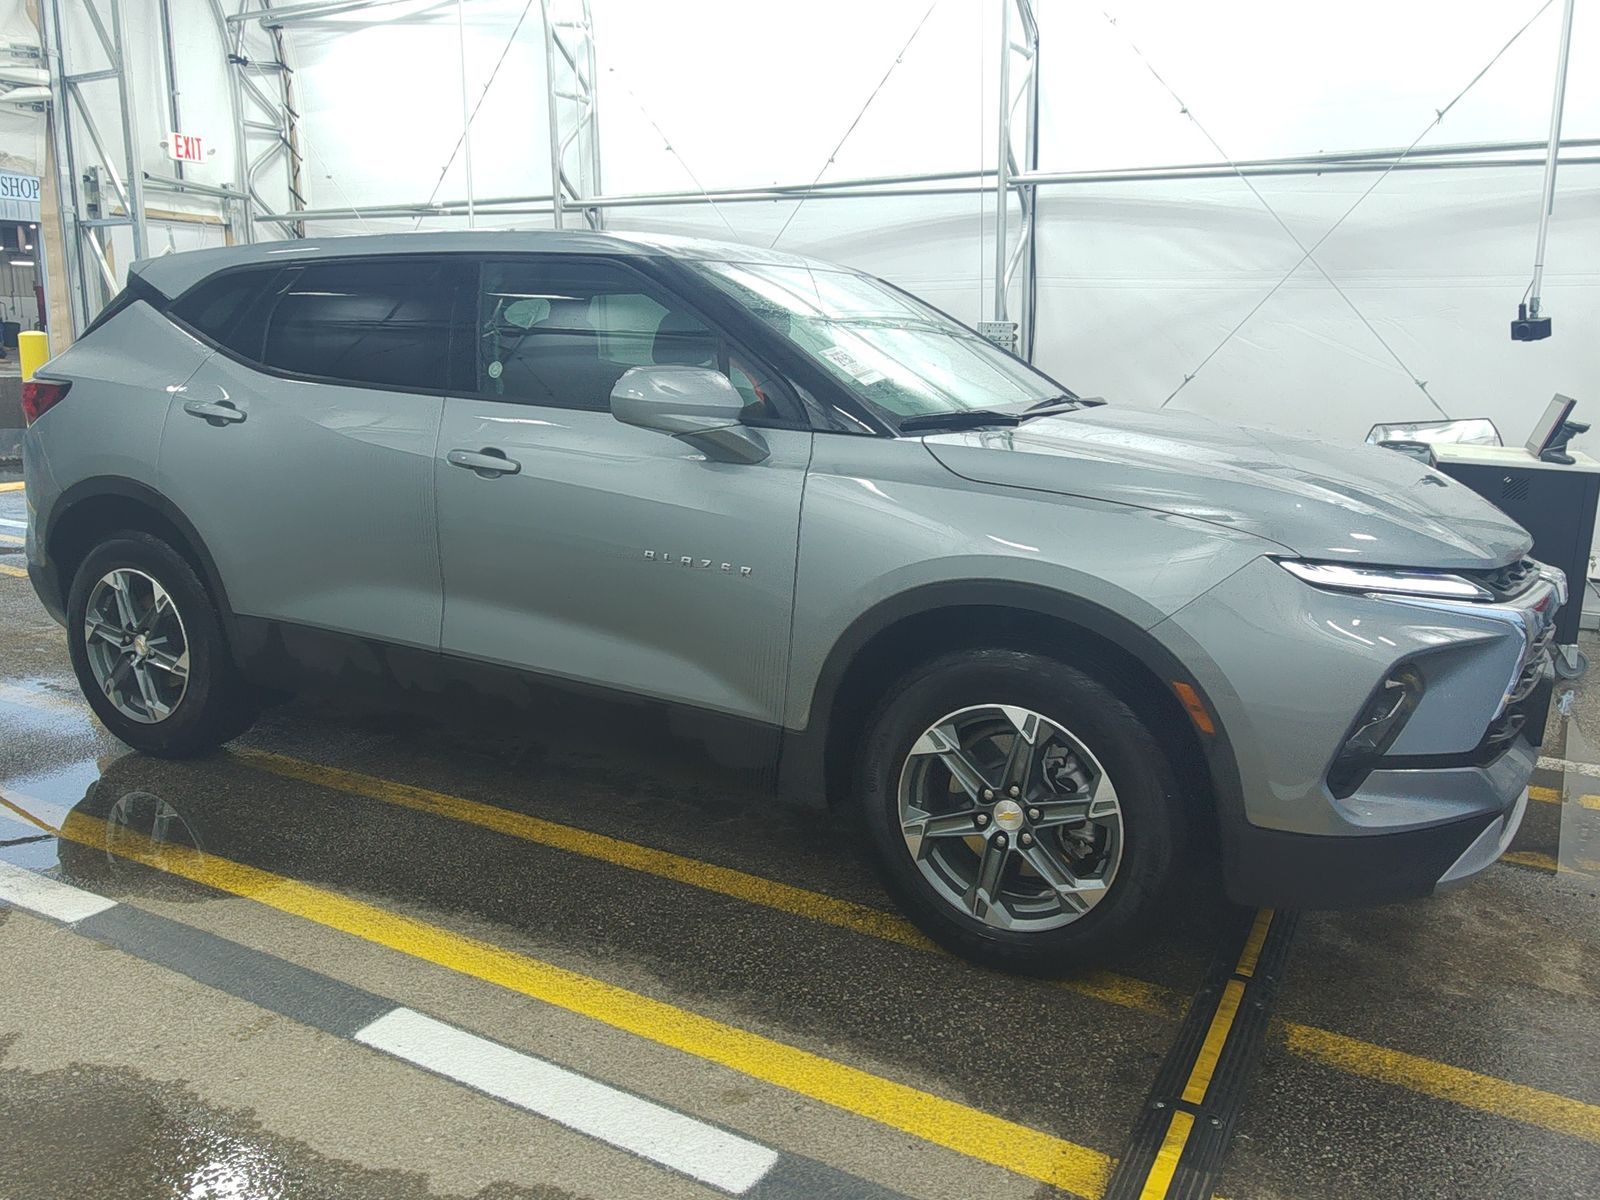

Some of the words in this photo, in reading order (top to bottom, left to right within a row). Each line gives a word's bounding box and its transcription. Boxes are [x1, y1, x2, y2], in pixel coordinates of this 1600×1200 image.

[174, 134, 202, 161] EXIT
[1, 175, 39, 199] SHOP
[644, 550, 753, 577] BLAZER
